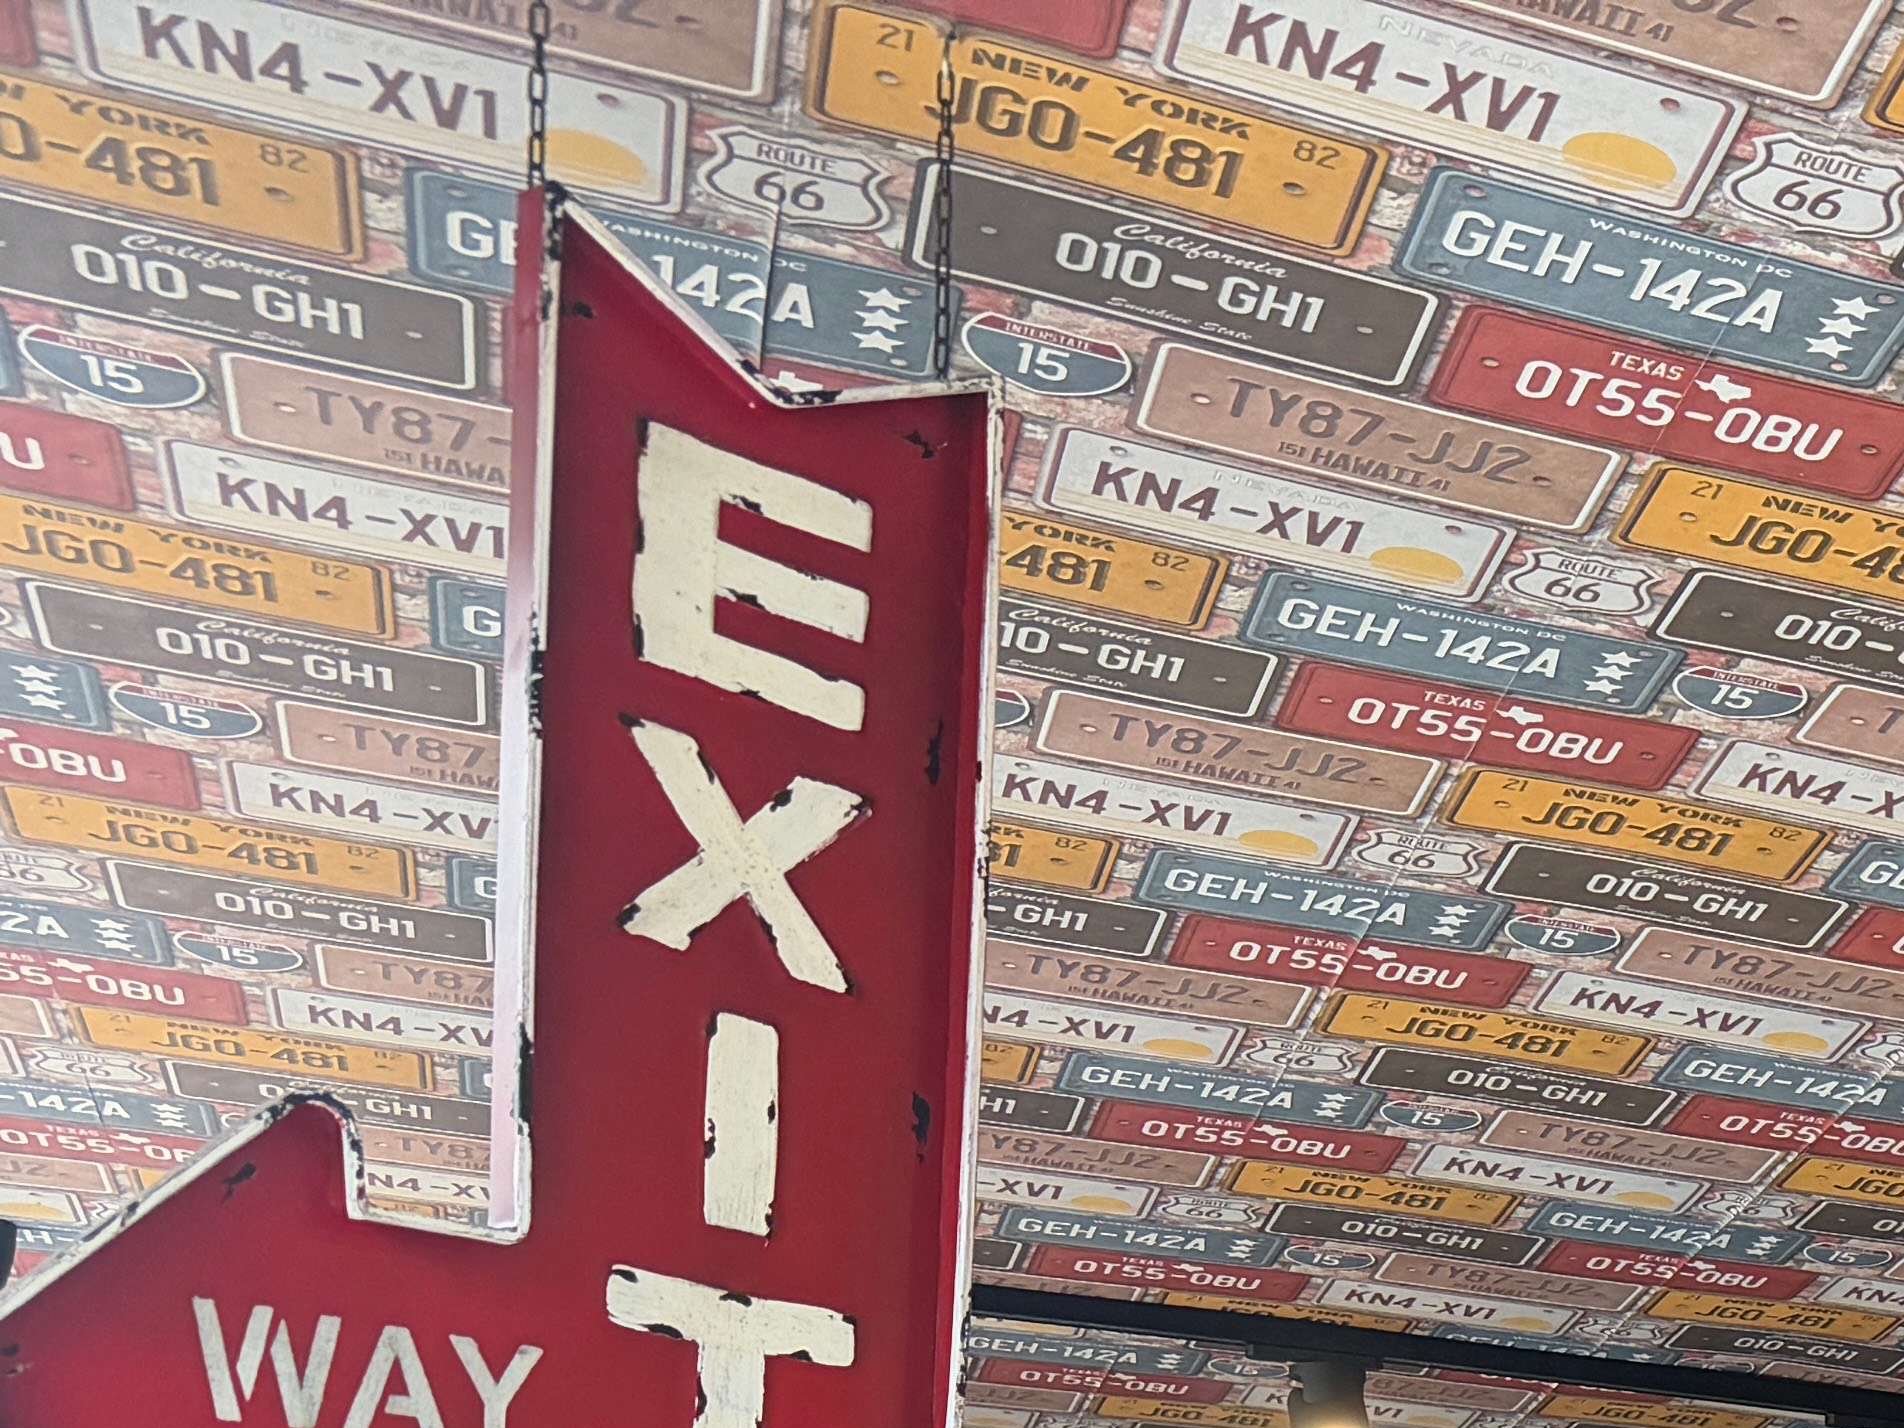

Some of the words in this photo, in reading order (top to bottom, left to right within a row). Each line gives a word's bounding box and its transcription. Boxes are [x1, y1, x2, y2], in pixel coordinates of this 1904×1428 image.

[971, 52, 1085, 91] NEW
[1113, 84, 1248, 125] YORK
[1292, 129, 1339, 159] 82
[1794, 151, 1873, 176] ROUTE
[1777, 182, 1841, 217] 66
[1113, 220, 1289, 281] California
[1589, 220, 1746, 265] WASHINGTON
[1442, 215, 1780, 328] GEH-142A
[1020, 345, 1069, 379] 15
[1610, 351, 1683, 377] TEXAS
[1277, 597, 1558, 675] GEH-142A
[1081, 1064, 1294, 1111] GEH-142A
